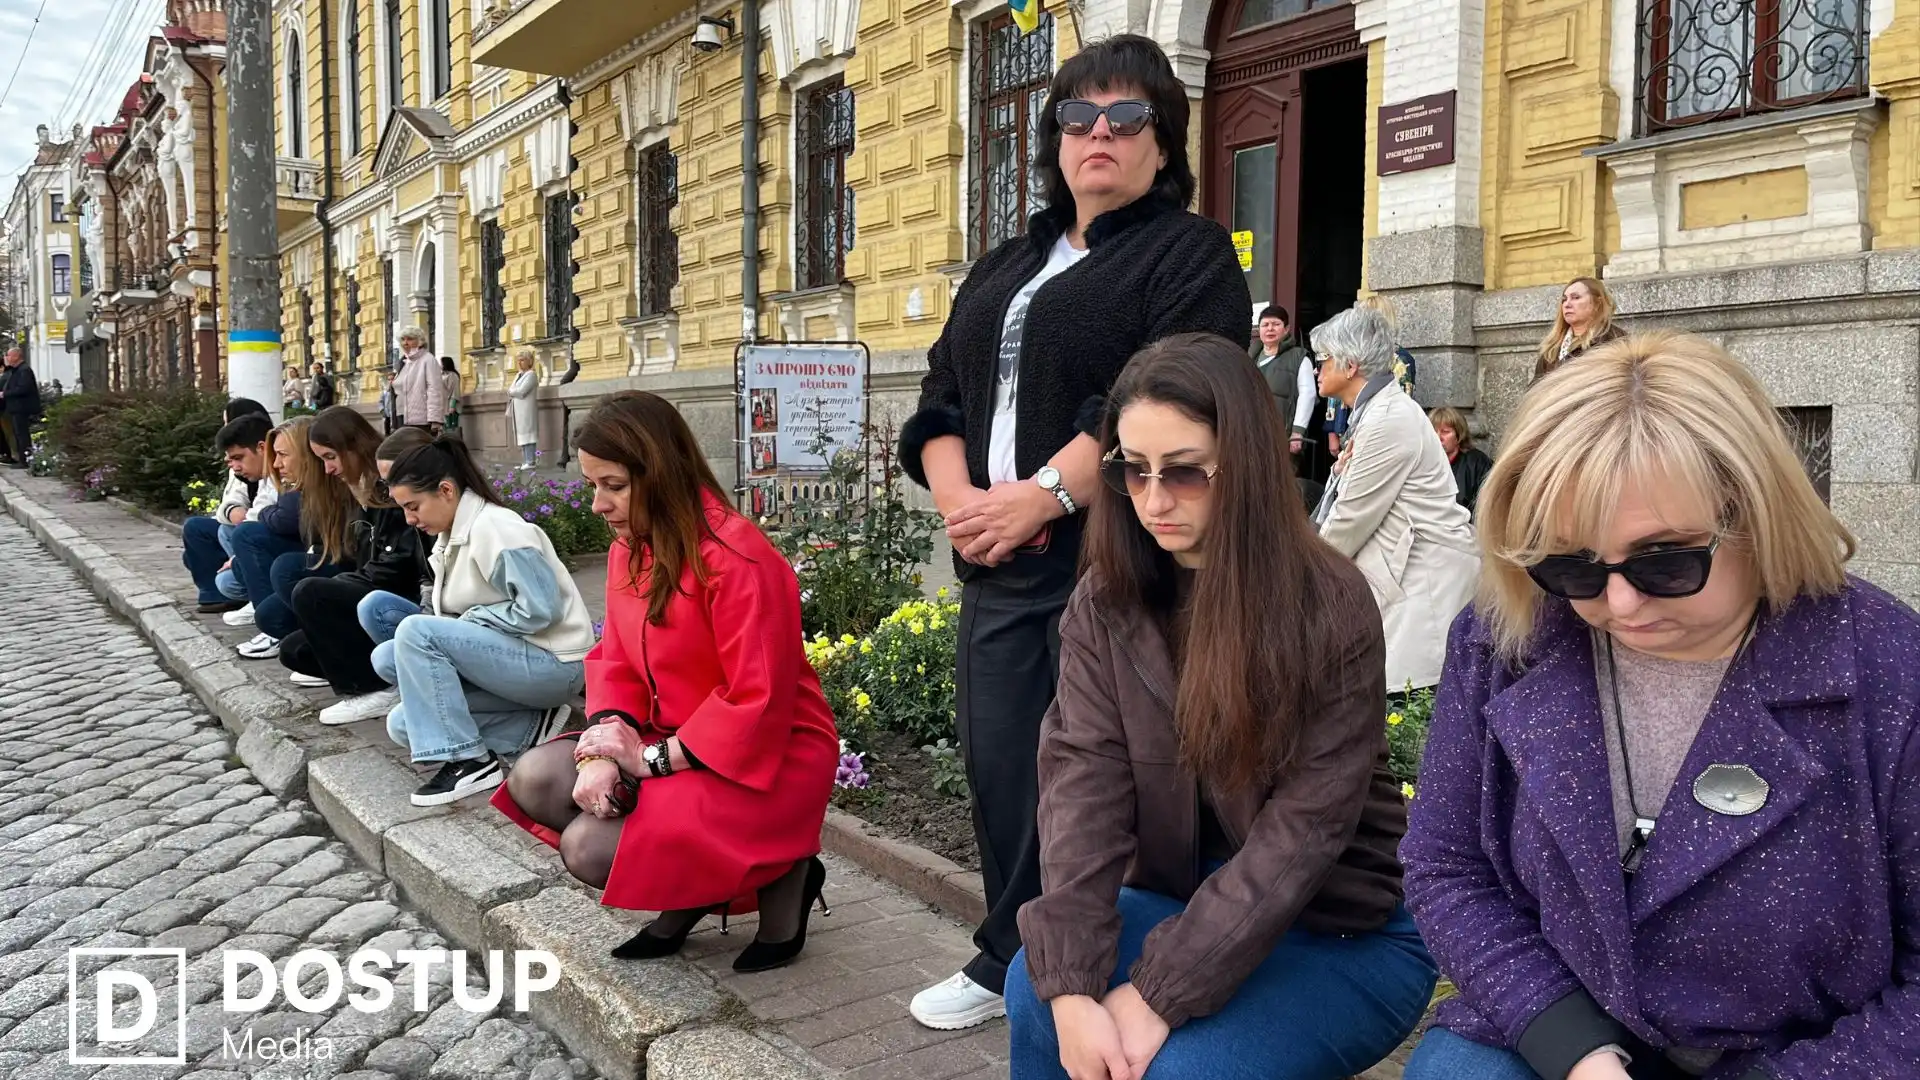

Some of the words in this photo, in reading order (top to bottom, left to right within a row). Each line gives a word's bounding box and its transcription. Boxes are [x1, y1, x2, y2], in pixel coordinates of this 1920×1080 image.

[1394, 124, 1434, 143] СУВЕНІРИ
[755, 362, 856, 376] ЗАПРОШУЄМО
[799, 378, 848, 390] відвідати
